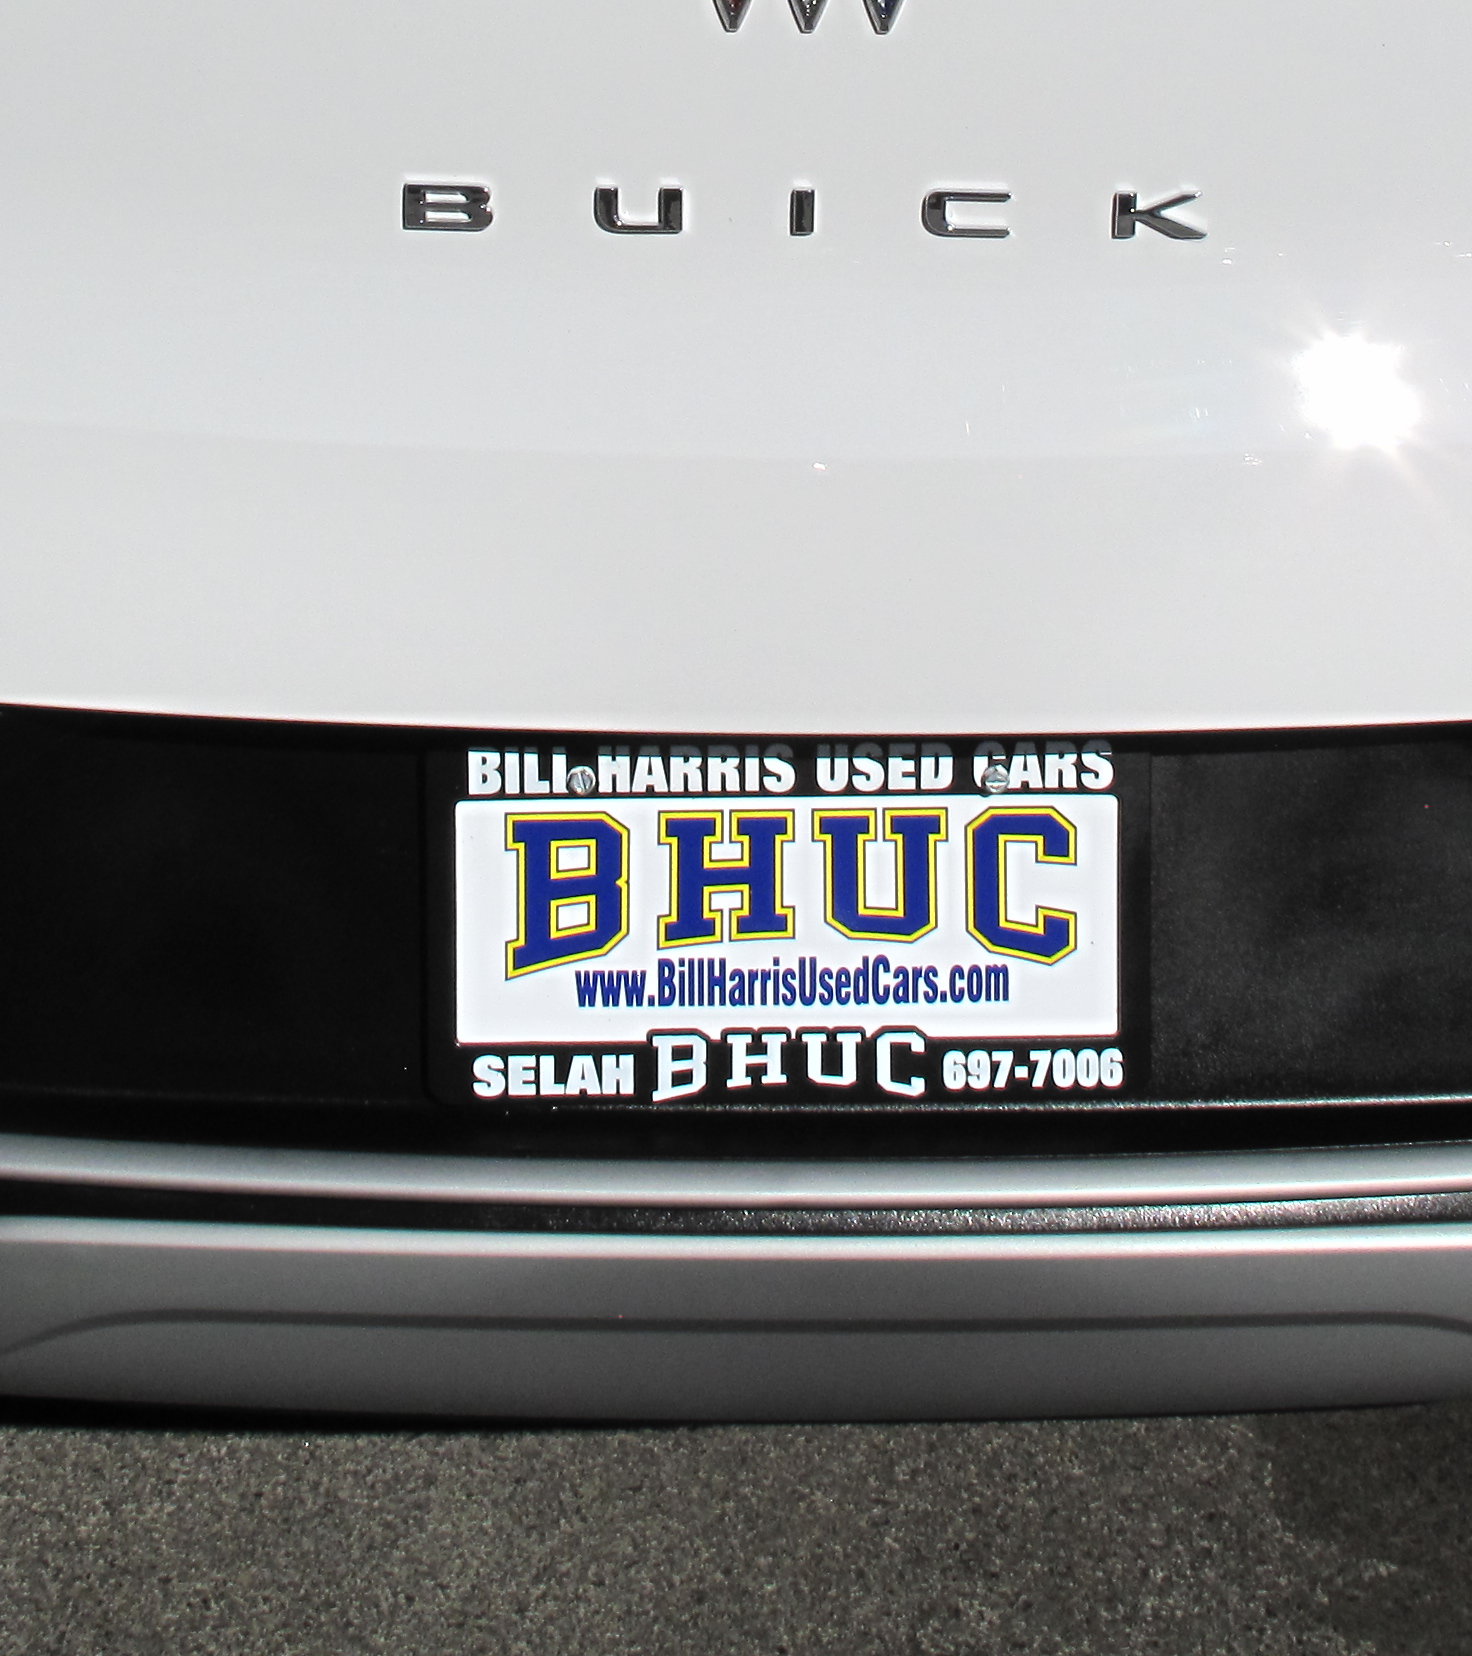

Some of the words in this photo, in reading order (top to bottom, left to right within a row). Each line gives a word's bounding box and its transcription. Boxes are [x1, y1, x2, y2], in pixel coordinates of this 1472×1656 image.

[402, 182, 1208, 240] BUICK
[468, 746, 567, 795] BILL
[597, 744, 796, 794] HARRIS
[816, 742, 953, 793] USED
[972, 739, 1114, 793] CARS
[505, 806, 1077, 981] BHUC
[574, 955, 1010, 1007] www.BillHarrisUsedCars.com
[472, 1053, 637, 1097] SELAH
[650, 1029, 927, 1104] BHUC
[942, 1047, 1125, 1091] 697-7006
